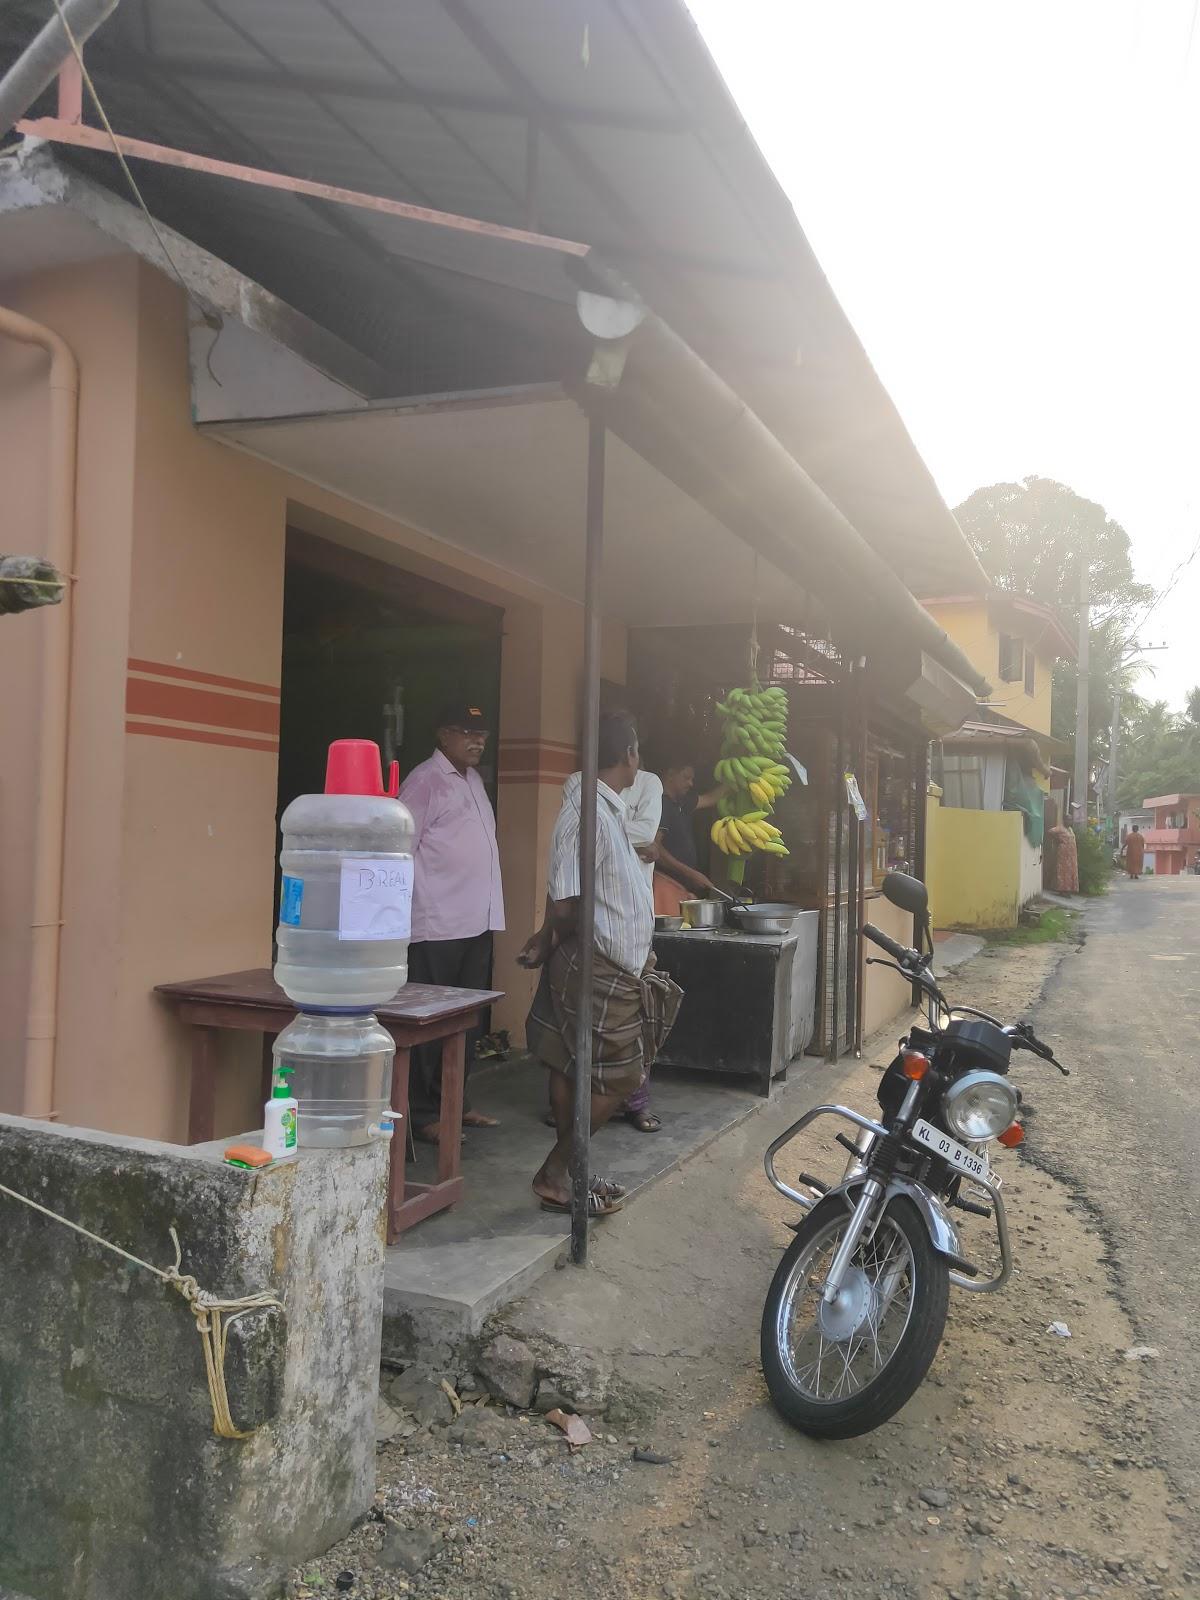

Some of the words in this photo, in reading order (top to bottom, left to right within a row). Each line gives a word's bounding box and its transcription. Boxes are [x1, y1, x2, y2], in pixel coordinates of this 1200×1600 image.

[919, 1126, 930, 1142] KL
[939, 1140, 950, 1153] 03
[954, 1150, 962, 1161] B
[963, 1155, 983, 1174] 1336
